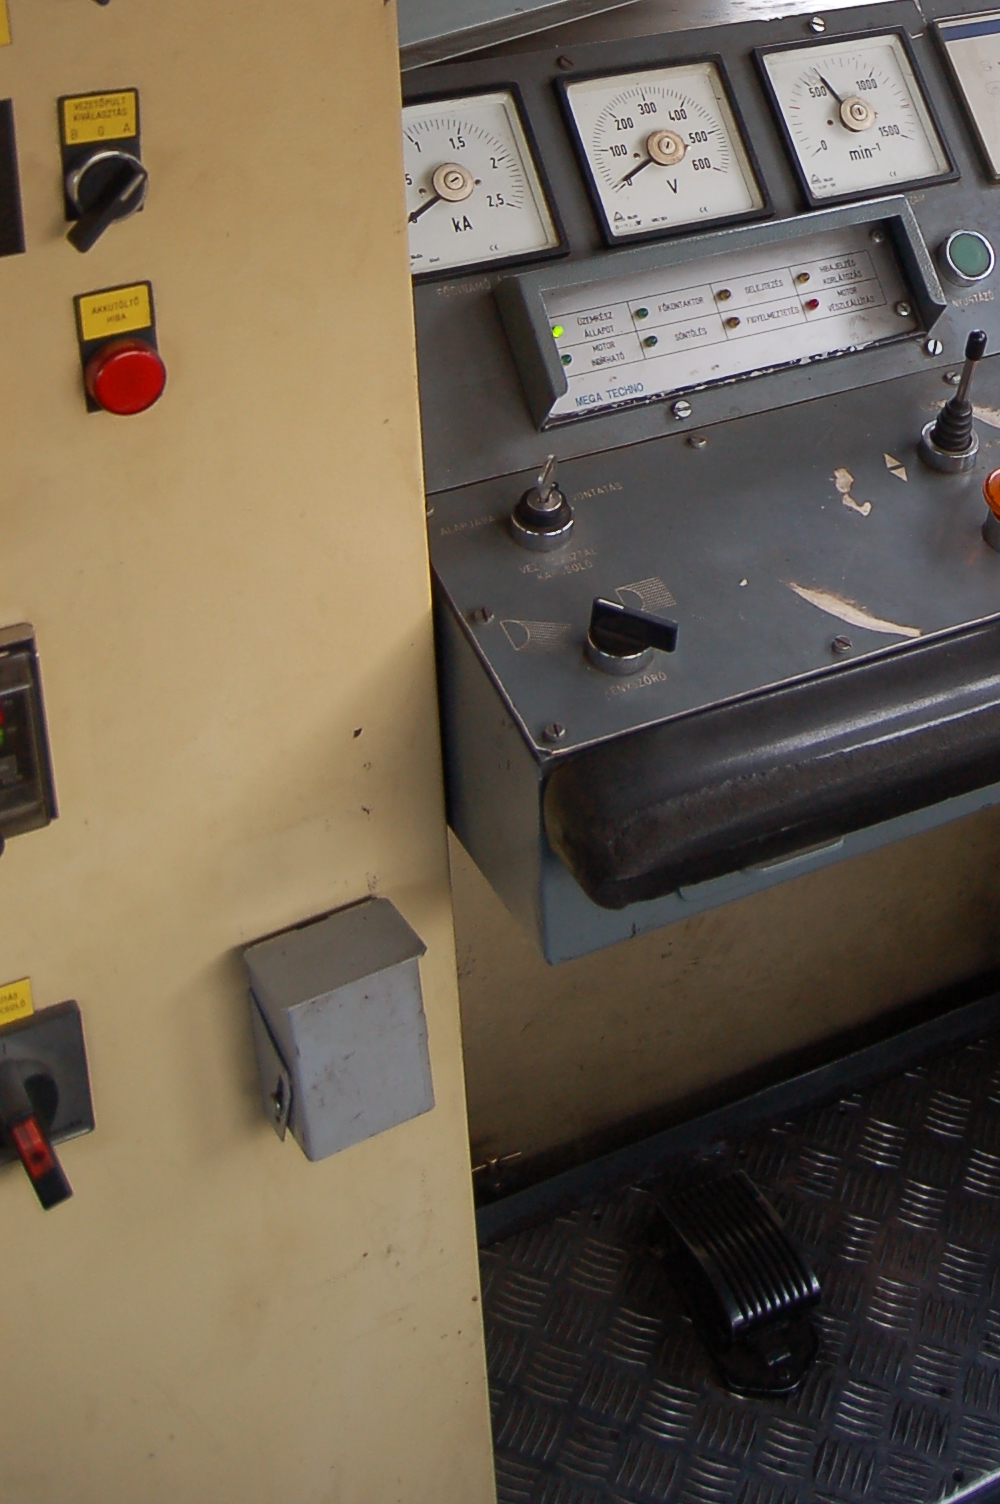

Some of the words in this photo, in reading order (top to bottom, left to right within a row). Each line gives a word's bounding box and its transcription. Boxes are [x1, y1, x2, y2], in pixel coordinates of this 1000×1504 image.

[809, 86, 827, 98] 500
[855, 79, 877, 91] 1000
[637, 102, 657, 115] 300
[668, 109, 687, 122] 400
[615, 117, 634, 130] 200
[689, 130, 708, 144] 500
[878, 124, 900, 138] 1500
[414, 141, 422, 153] 1
[449, 136, 466, 150] 1,5
[821, 139, 828, 151] 0
[610, 144, 628, 158] 100
[490, 157, 498, 169] 2
[692, 157, 711, 171] 600
[667, 179, 677, 194] V
[486, 193, 505, 208] 2,5
[452, 215, 473, 233] kA
[606, 382, 644, 400] TECHNO
